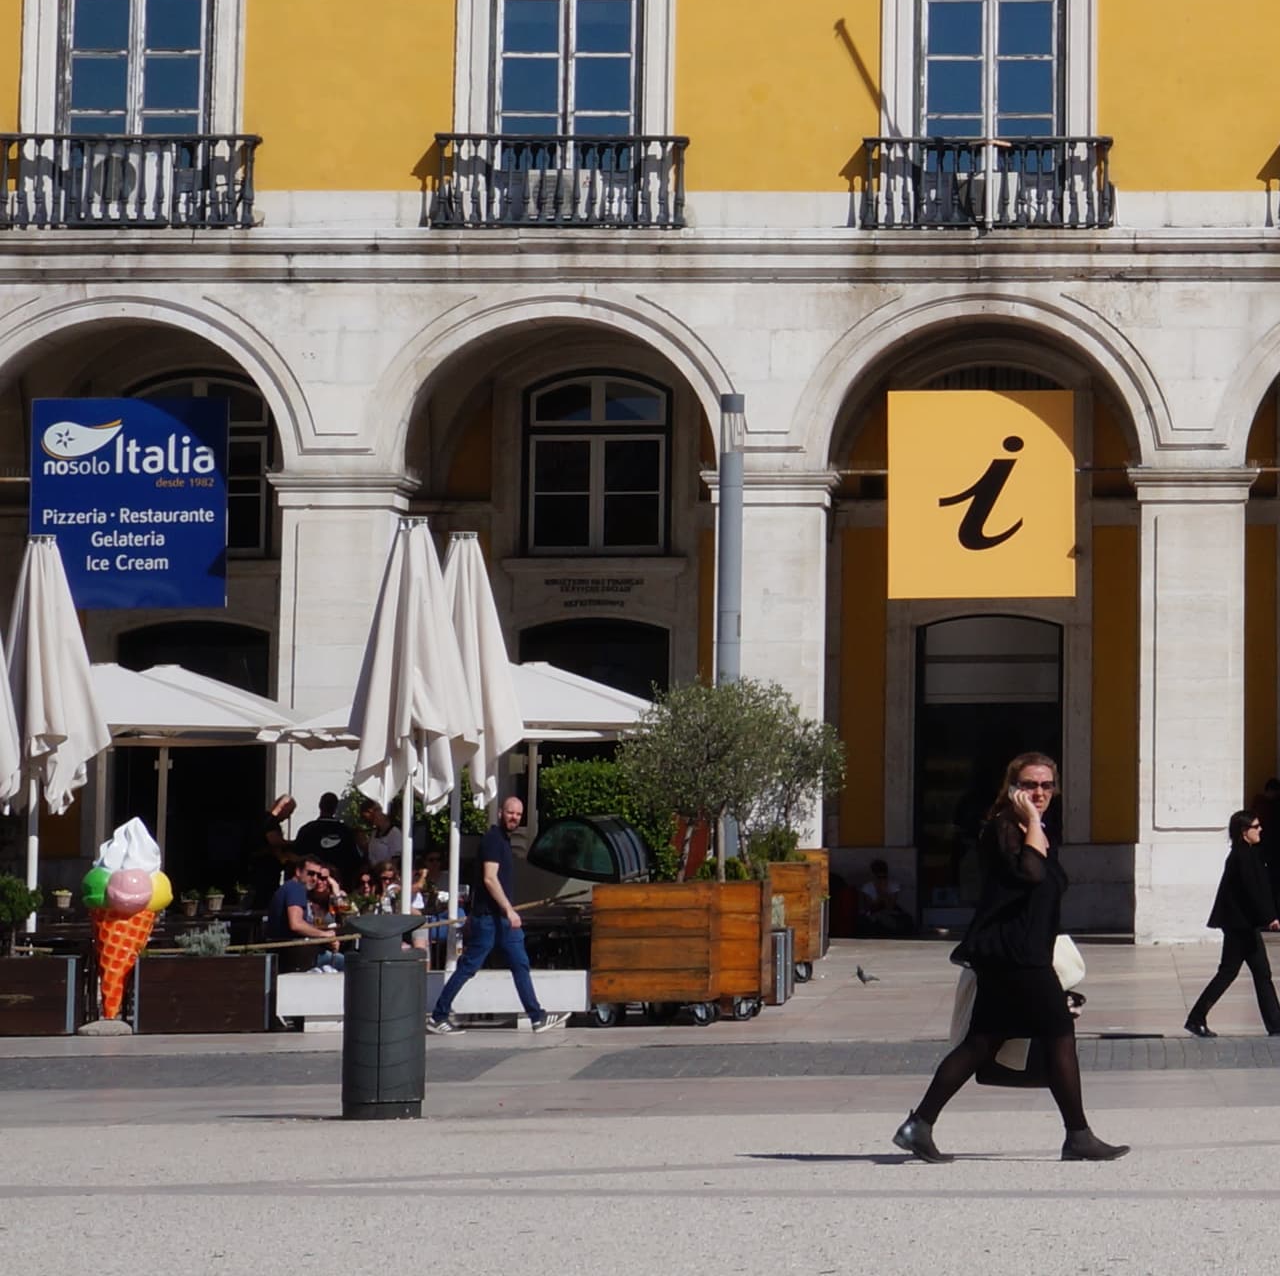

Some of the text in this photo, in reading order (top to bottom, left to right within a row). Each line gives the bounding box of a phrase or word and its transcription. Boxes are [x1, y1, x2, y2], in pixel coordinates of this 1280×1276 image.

[43, 433, 215, 475] nosolo Italia
[156, 477, 215, 488] desde 1982
[43, 507, 215, 525] Pizzeria Restaurante
[91, 530, 165, 547] Gelateria
[86, 554, 169, 571] Ice Cream
